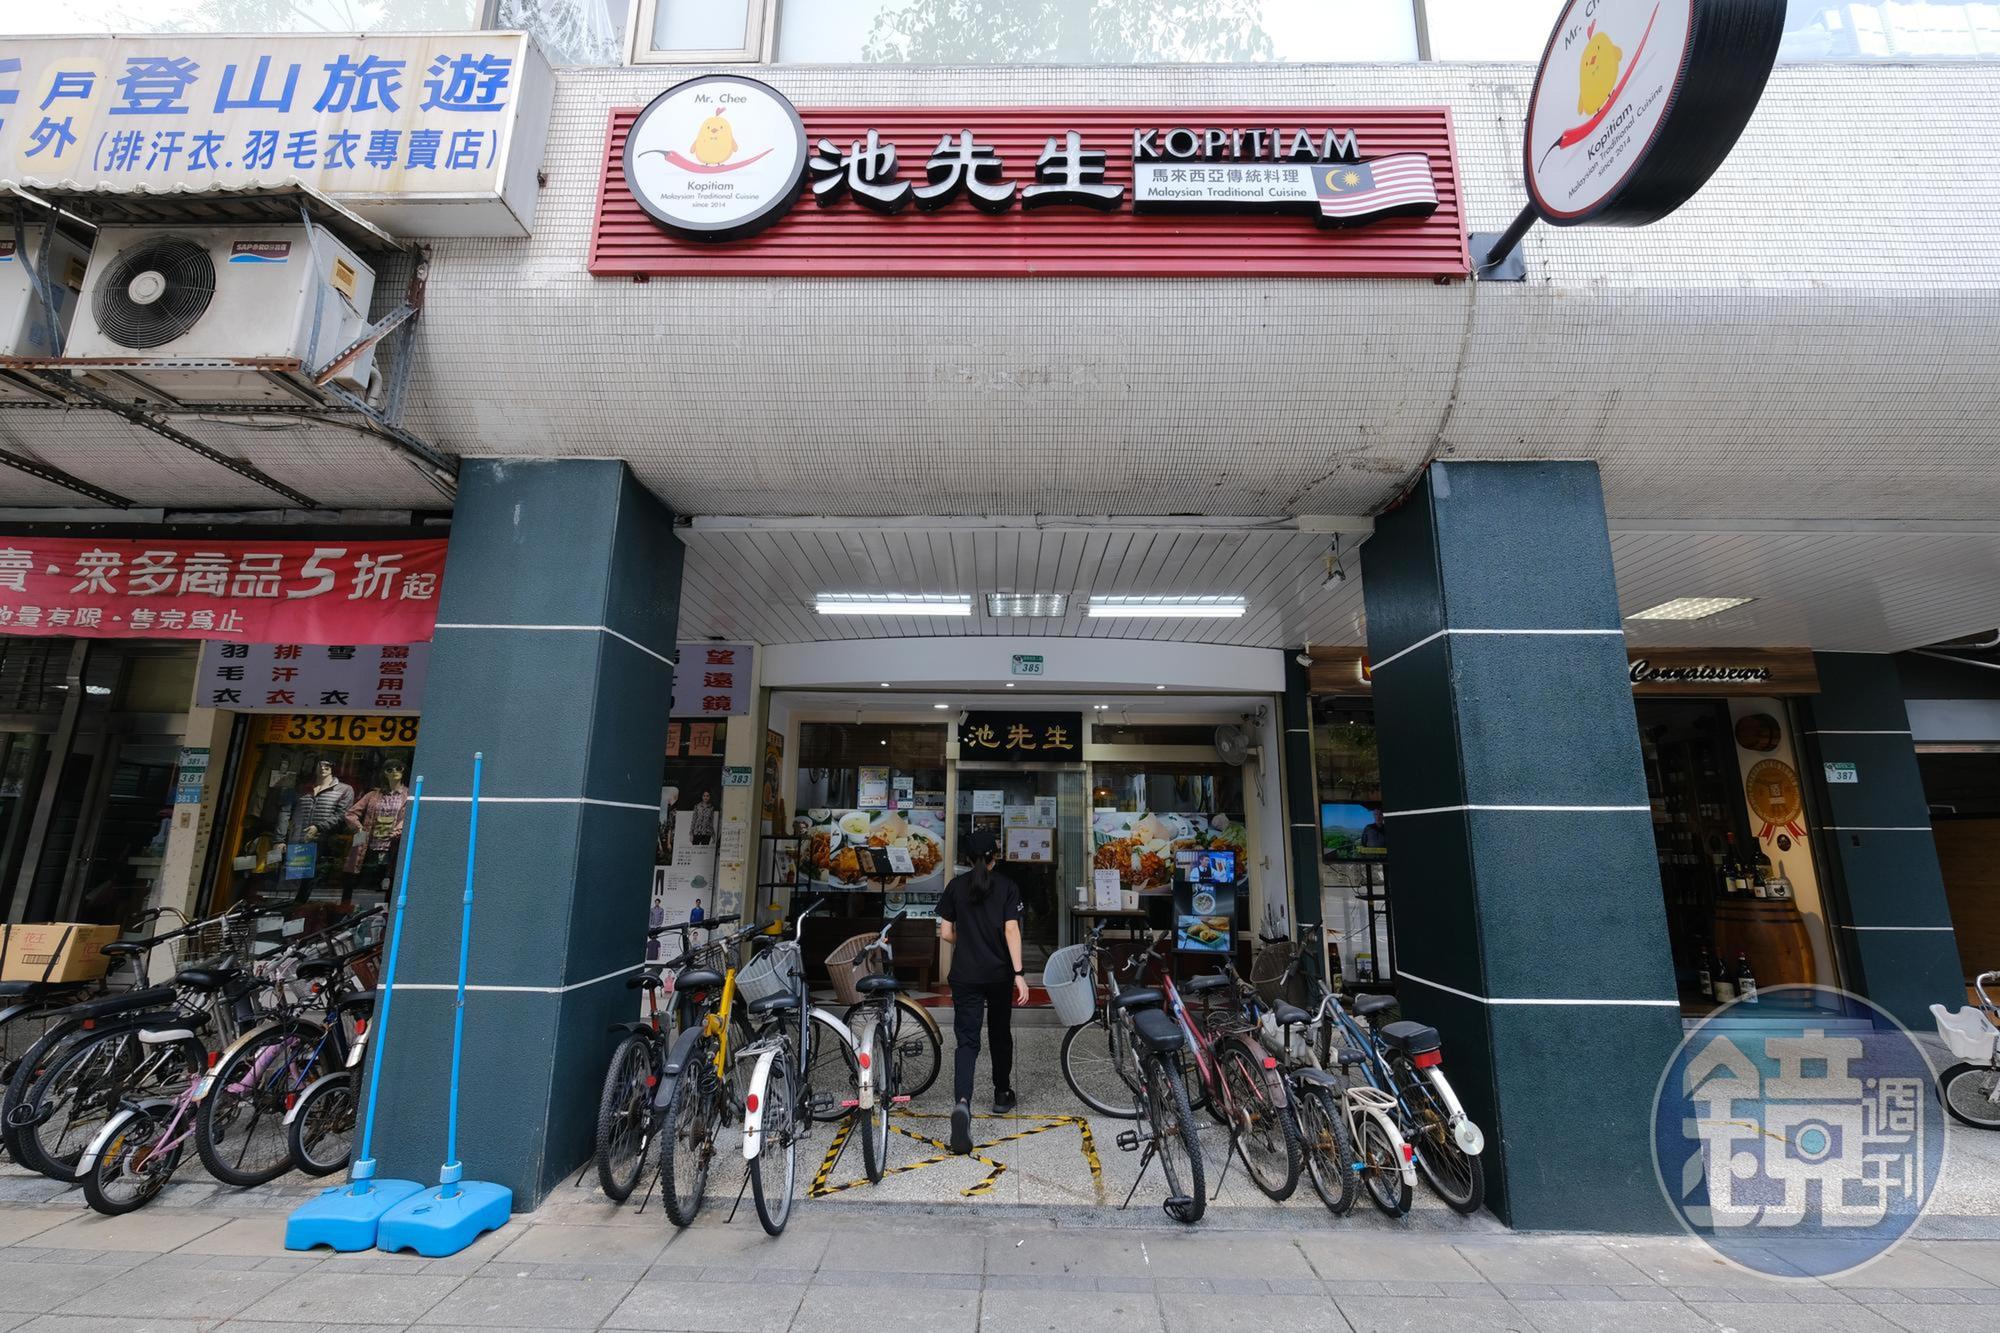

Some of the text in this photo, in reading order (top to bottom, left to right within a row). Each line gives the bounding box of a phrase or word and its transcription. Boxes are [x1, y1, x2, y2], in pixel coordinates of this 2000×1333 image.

[1564, 24, 1582, 51] Mr.
[108, 52, 513, 116] 登山旅遊
[694, 93, 747, 104] Mr. Chee
[1134, 127, 1360, 161] KOPITIAM
[1568, 85, 1664, 200] Malaysian Traditional Cuisine
[1587, 103, 1633, 161] Kopitiam
[809, 128, 1124, 206] 池先生
[1597, 135, 1631, 178] since 2014
[687, 180, 734, 194] Kopitiam
[1151, 168, 1300, 184] 馬來西亞傳統料理
[660, 192, 760, 202] Malaysian Traditional Cuisine
[1147, 186, 1307, 199] Malaysian Traditional Cuisine
[213, 643, 249, 703] 羽毛衣
[266, 643, 303, 705] 排汗衣
[375, 645, 410, 707] 露營用品
[702, 649, 735, 711] 望遠鏡
[1022, 663, 1040, 672] 385
[1629, 659, 1774, 683] Connaisseurs
[967, 723, 1074, 750] 池先生
[731, 775, 749, 784] 383
[1836, 771, 1853, 780] 387
